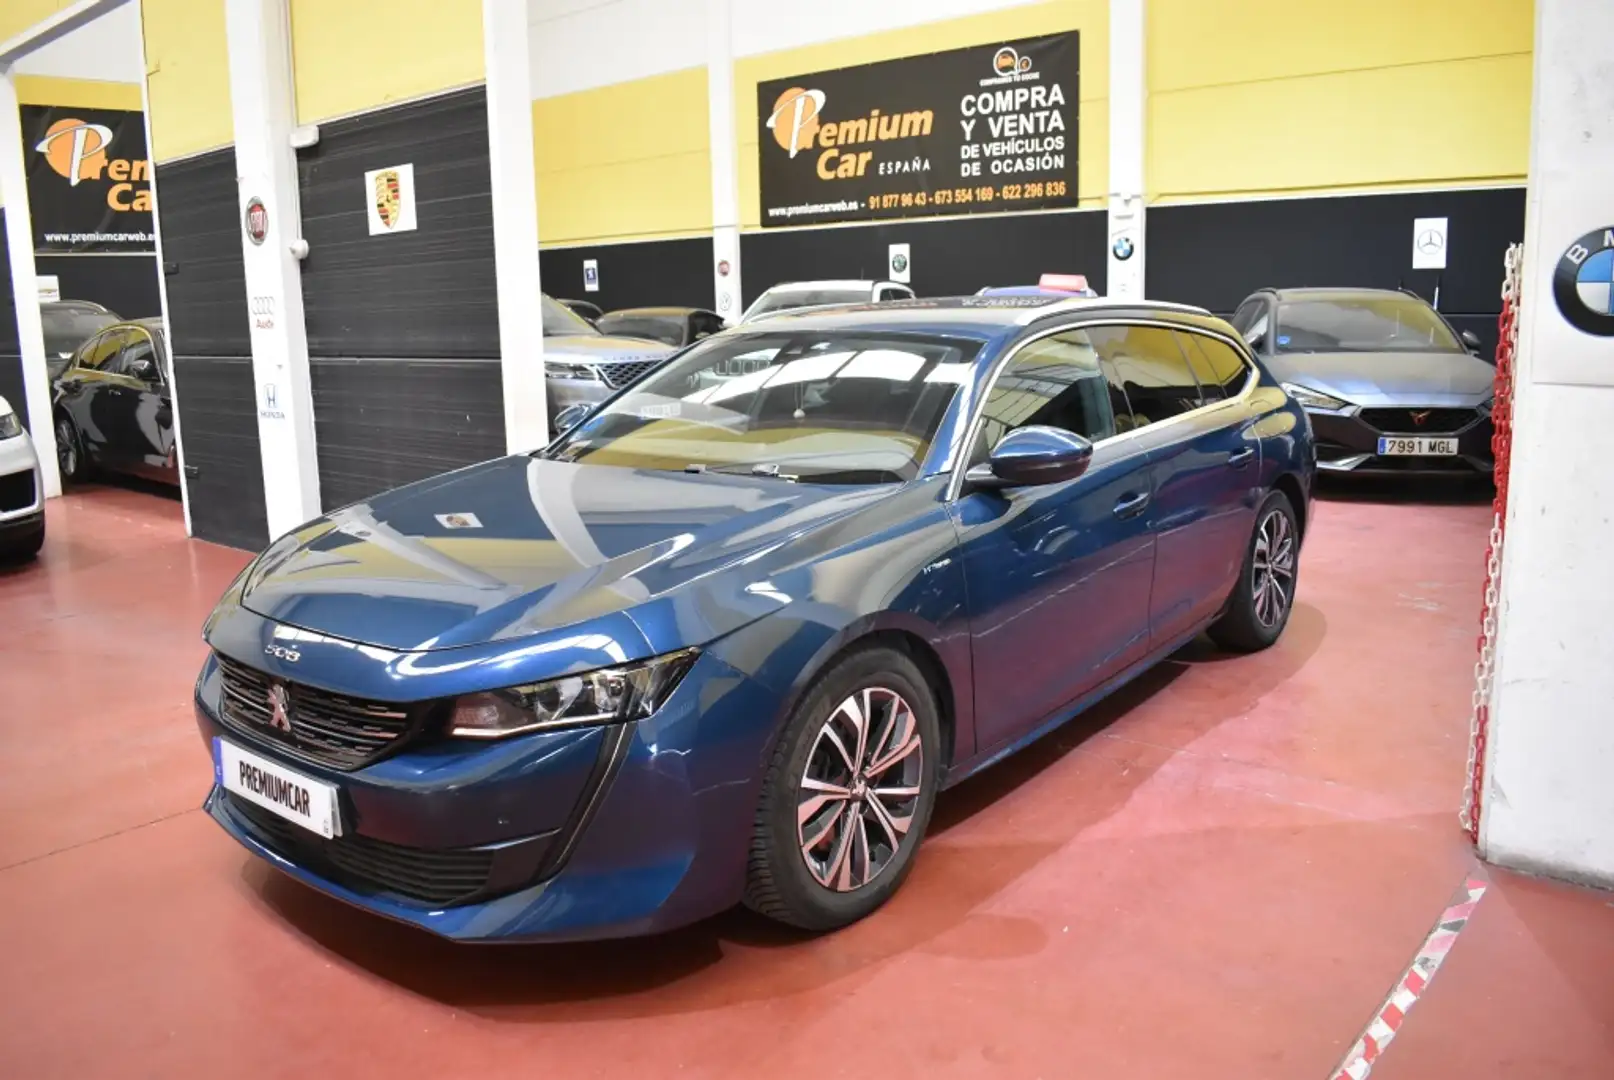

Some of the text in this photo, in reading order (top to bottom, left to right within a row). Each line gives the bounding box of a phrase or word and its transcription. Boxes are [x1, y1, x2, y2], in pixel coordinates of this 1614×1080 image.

[961, 83, 1066, 117] COMPRA
[766, 88, 934, 159] Premium
[960, 109, 1066, 142] Y VENTA
[961, 135, 1065, 159] DE VEHÍCULOS
[816, 148, 931, 180] Car ESPAÑA
[961, 151, 1065, 177] DE OCASIÓN
[107, 183, 153, 212] Ca
[868, 196, 880, 209] 91
[914, 192, 927, 206] 43
[934, 190, 953, 205] 673
[955, 188, 973, 203] 554
[975, 187, 994, 201] 169
[1002, 184, 1022, 200] 622
[1024, 182, 1043, 198] 296
[1045, 181, 1066, 197] 836
[1388, 440, 1454, 454] 7991 MGL
[239, 760, 311, 818] PREMIUMCAR
